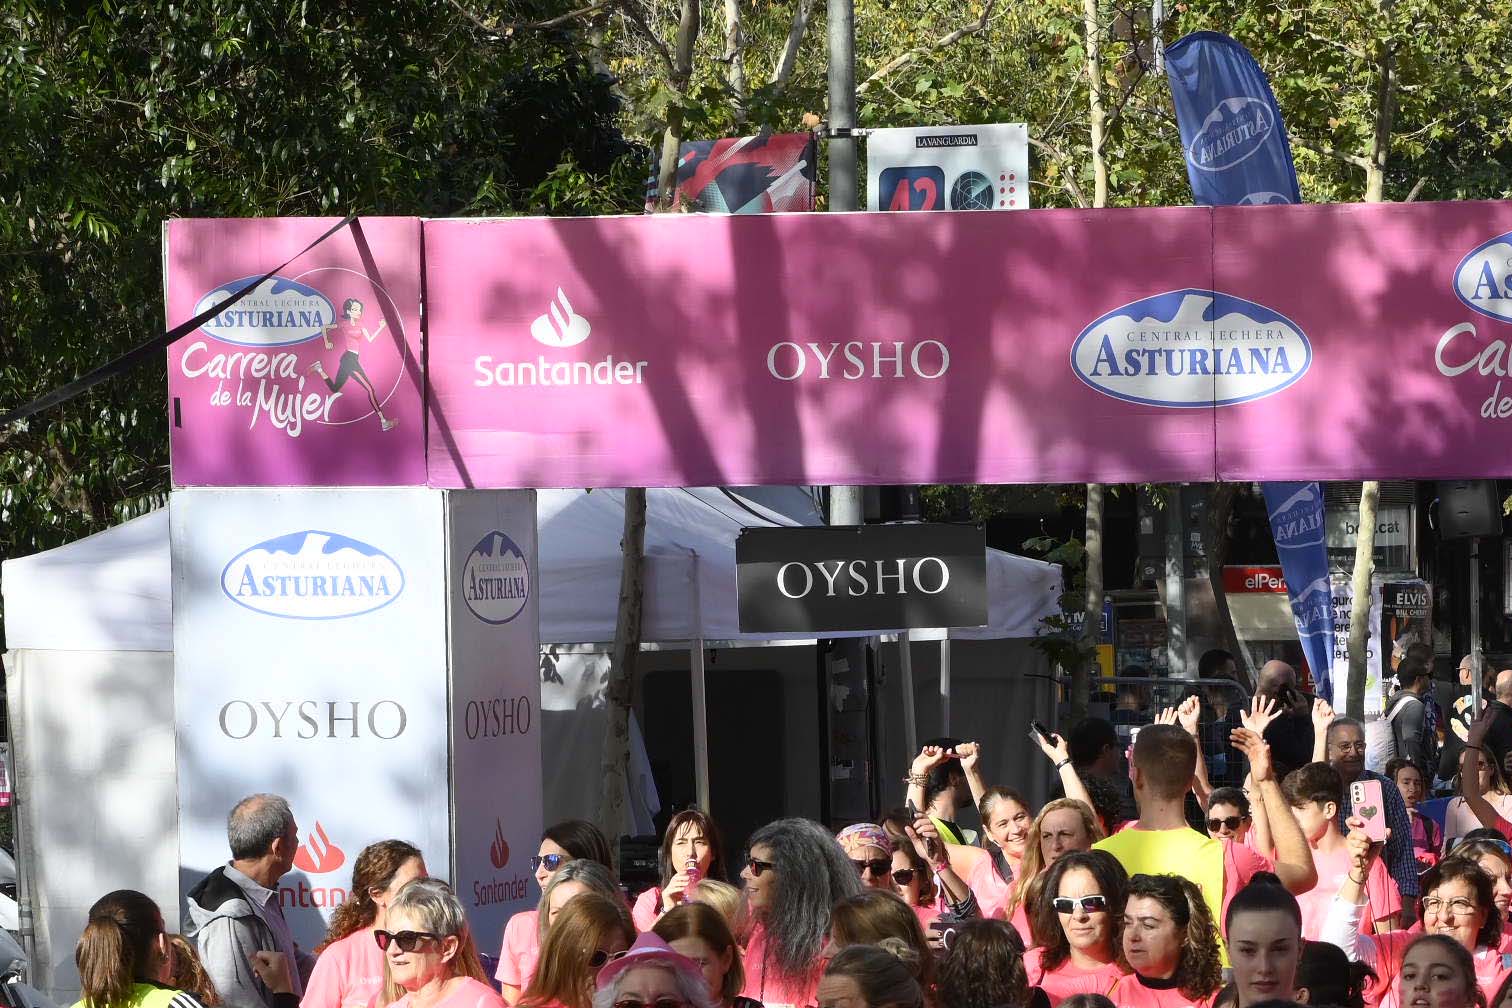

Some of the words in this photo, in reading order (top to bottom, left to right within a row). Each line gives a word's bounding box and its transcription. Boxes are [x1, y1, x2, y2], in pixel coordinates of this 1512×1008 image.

[928, 136, 977, 147] VANGUARDIA
[1126, 330, 1201, 342] CENTRAL
[1209, 329, 1285, 341] LECHERA
[180, 341, 298, 379] Carrera
[474, 354, 648, 386] Santander
[766, 339, 950, 381] OYSHO
[1089, 334, 1294, 377] ASTURIANA
[209, 379, 231, 407] de
[236, 378, 252, 407] la
[249, 375, 343, 438] Mujer
[1480, 380, 1512, 419] de
[235, 563, 392, 597] ASTURIANA
[468, 565, 526, 601] ASTURIANA
[776, 557, 951, 599] OYSHO
[1396, 592, 1427, 606] ELVIS
[218, 699, 408, 740] OYSHO
[465, 695, 531, 740] OYSHO
[472, 878, 529, 907] Santander
